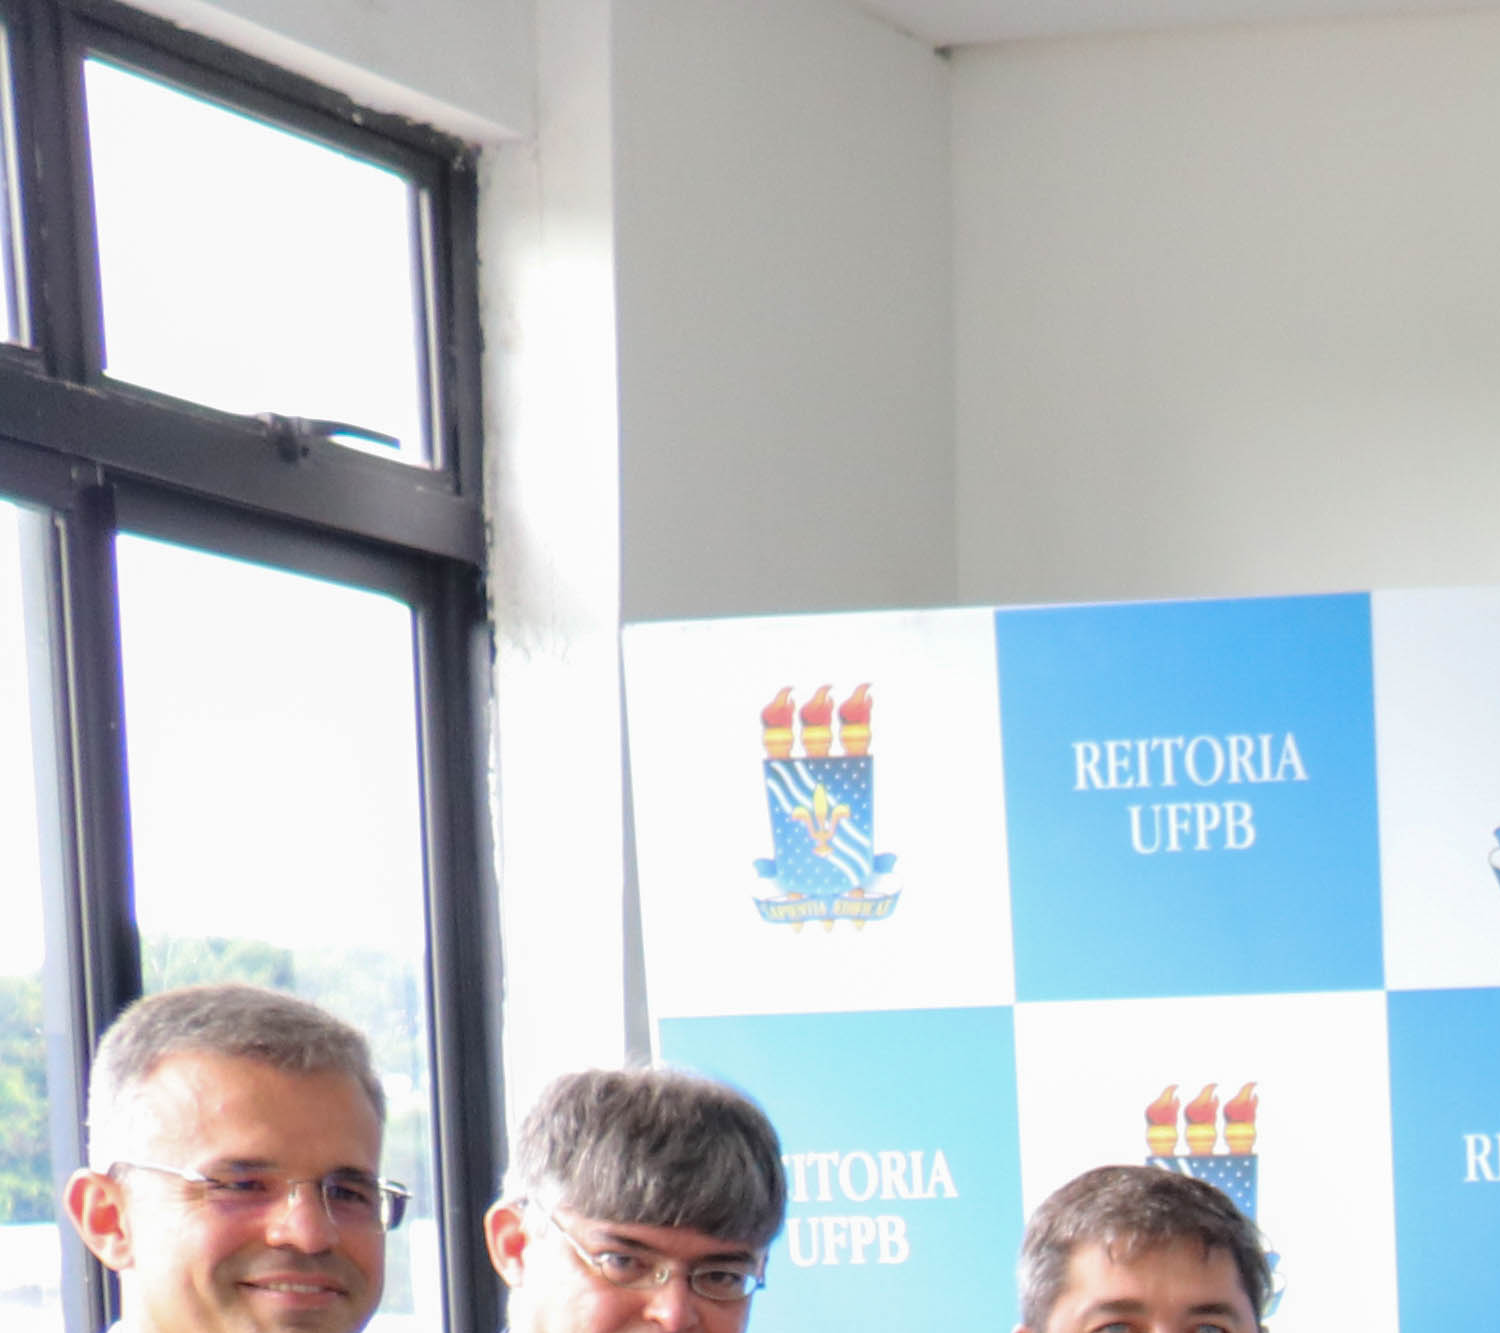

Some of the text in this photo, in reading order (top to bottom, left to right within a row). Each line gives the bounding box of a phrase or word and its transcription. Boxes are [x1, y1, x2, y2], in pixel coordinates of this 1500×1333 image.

[1071, 732, 1309, 791] REITORIA
[1129, 801, 1256, 855] UFPB
[781, 1149, 959, 1203] ITORIA
[787, 1214, 910, 1268] UFPB
